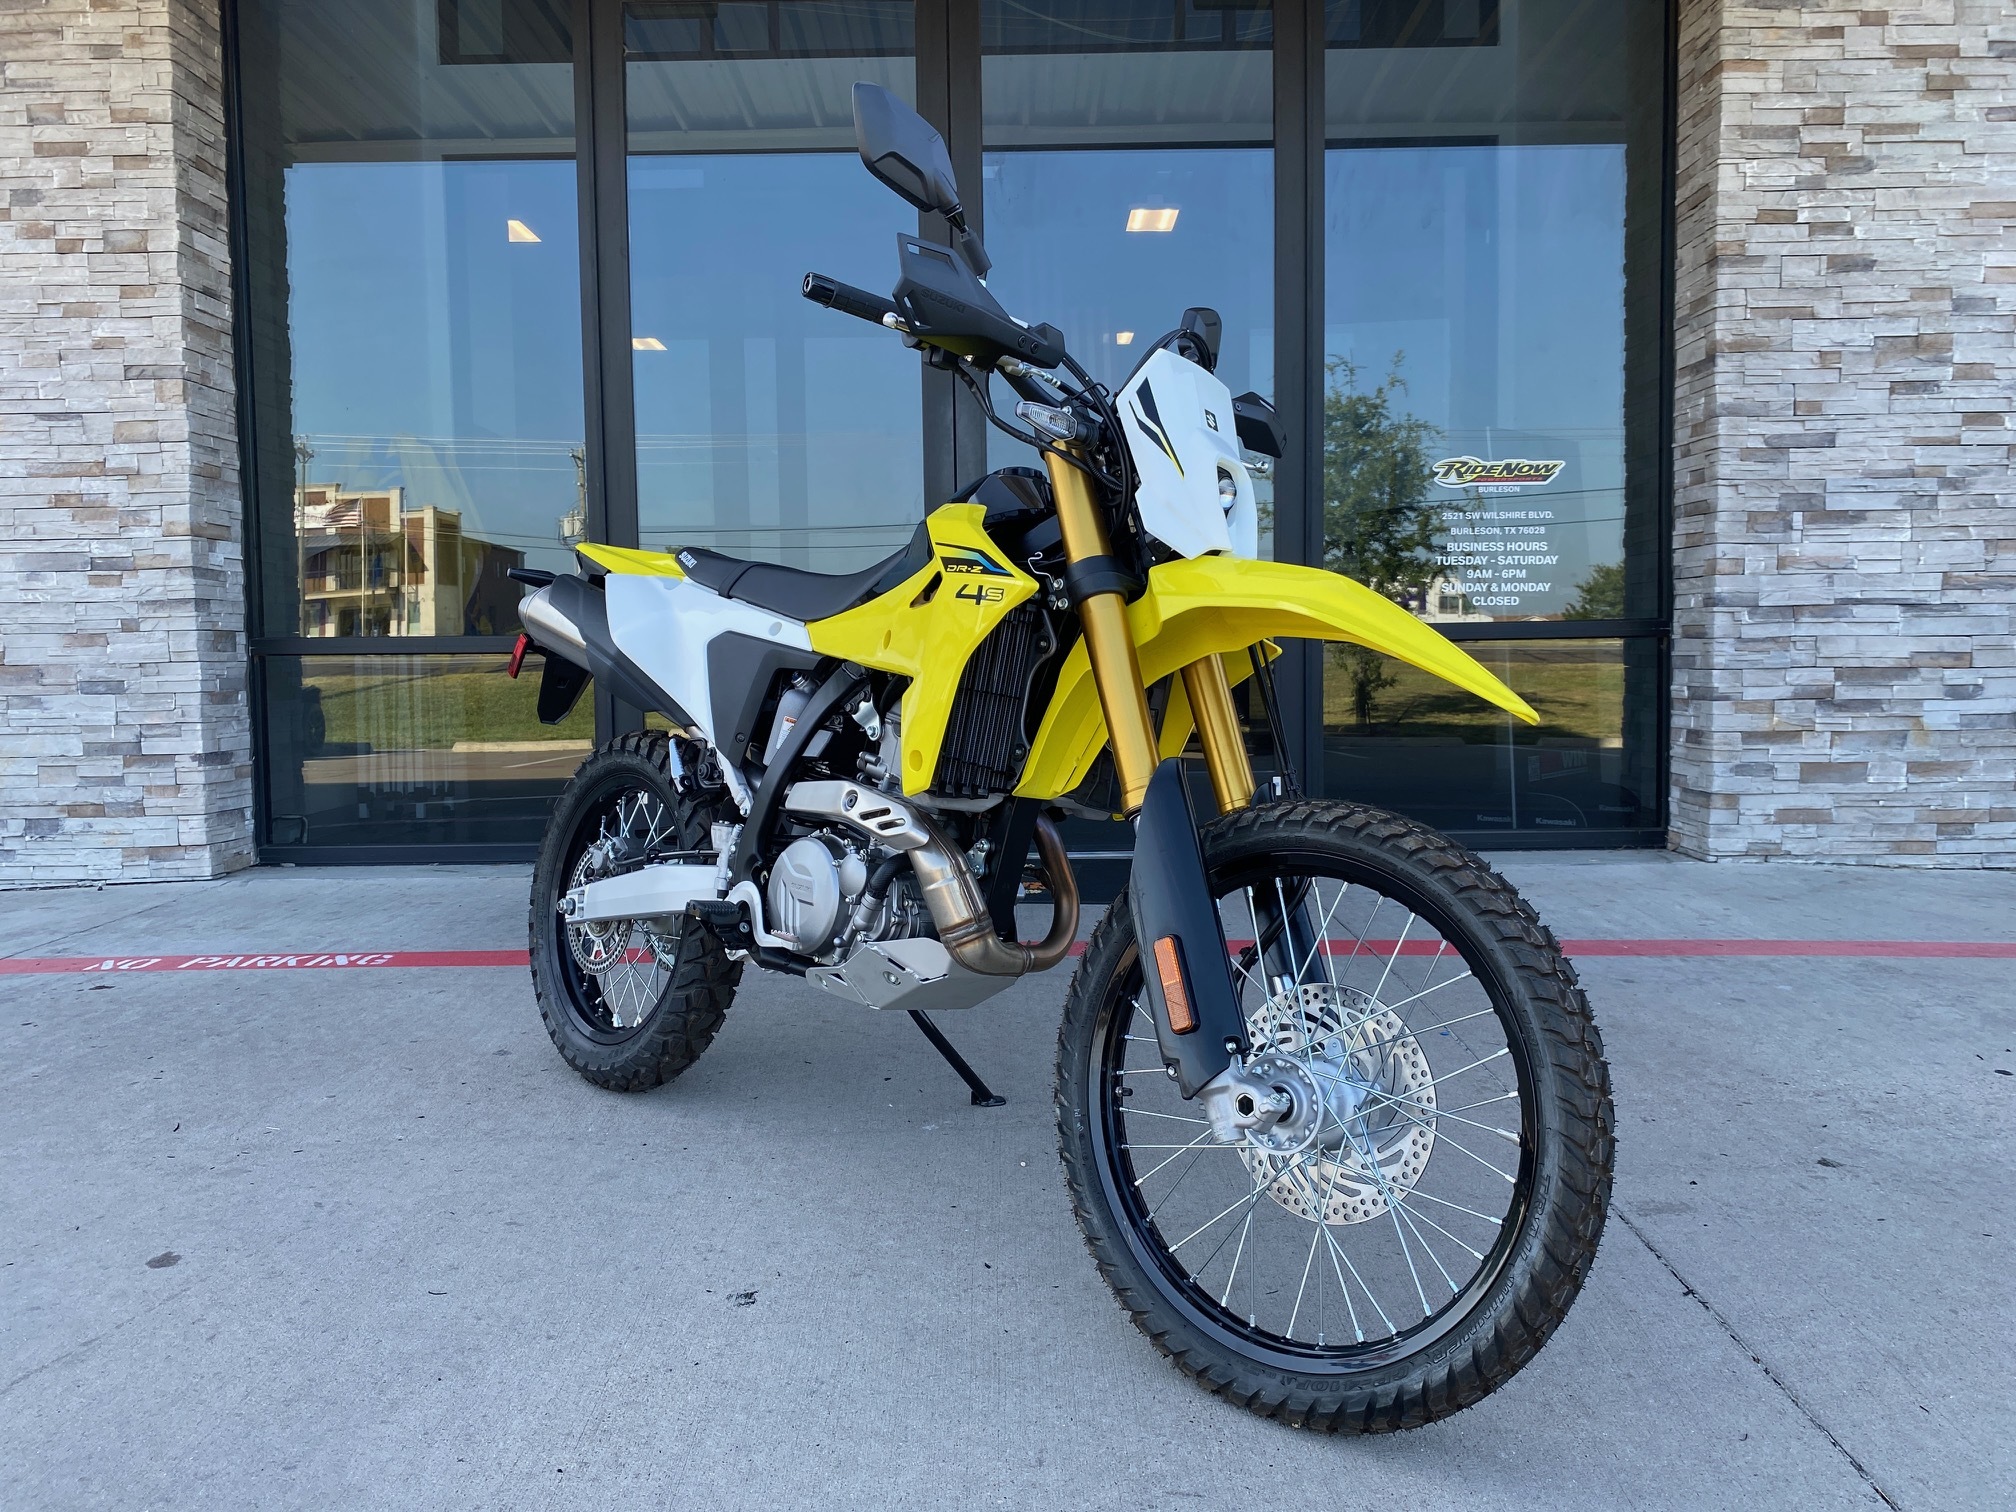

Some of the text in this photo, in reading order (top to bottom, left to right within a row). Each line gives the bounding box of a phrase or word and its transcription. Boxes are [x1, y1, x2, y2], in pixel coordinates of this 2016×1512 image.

[921, 288, 966, 314] SUZUKI
[1441, 511, 1554, 520] 2521 SW WILSHIRE BLVD.
[1450, 526, 1546, 535] BURLESON, TX 76028
[1446, 542, 1548, 552] BUSINESS HOURS
[678, 551, 698, 568] SUZUKI
[1435, 555, 1489, 566] TUESDAY
[1497, 555, 1559, 565] SATURDAY
[1466, 569, 1492, 579] 9AM
[1501, 569, 1526, 578] 6PM
[1441, 582, 1551, 592] SUNDAY & MONDAY
[955, 583, 1004, 606] 4S
[1472, 596, 1520, 606] CLOSED
[1477, 814, 1513, 823] Kawasak
[1535, 817, 1576, 826] Kawasaki
[83, 954, 394, 971] NO PARKING
